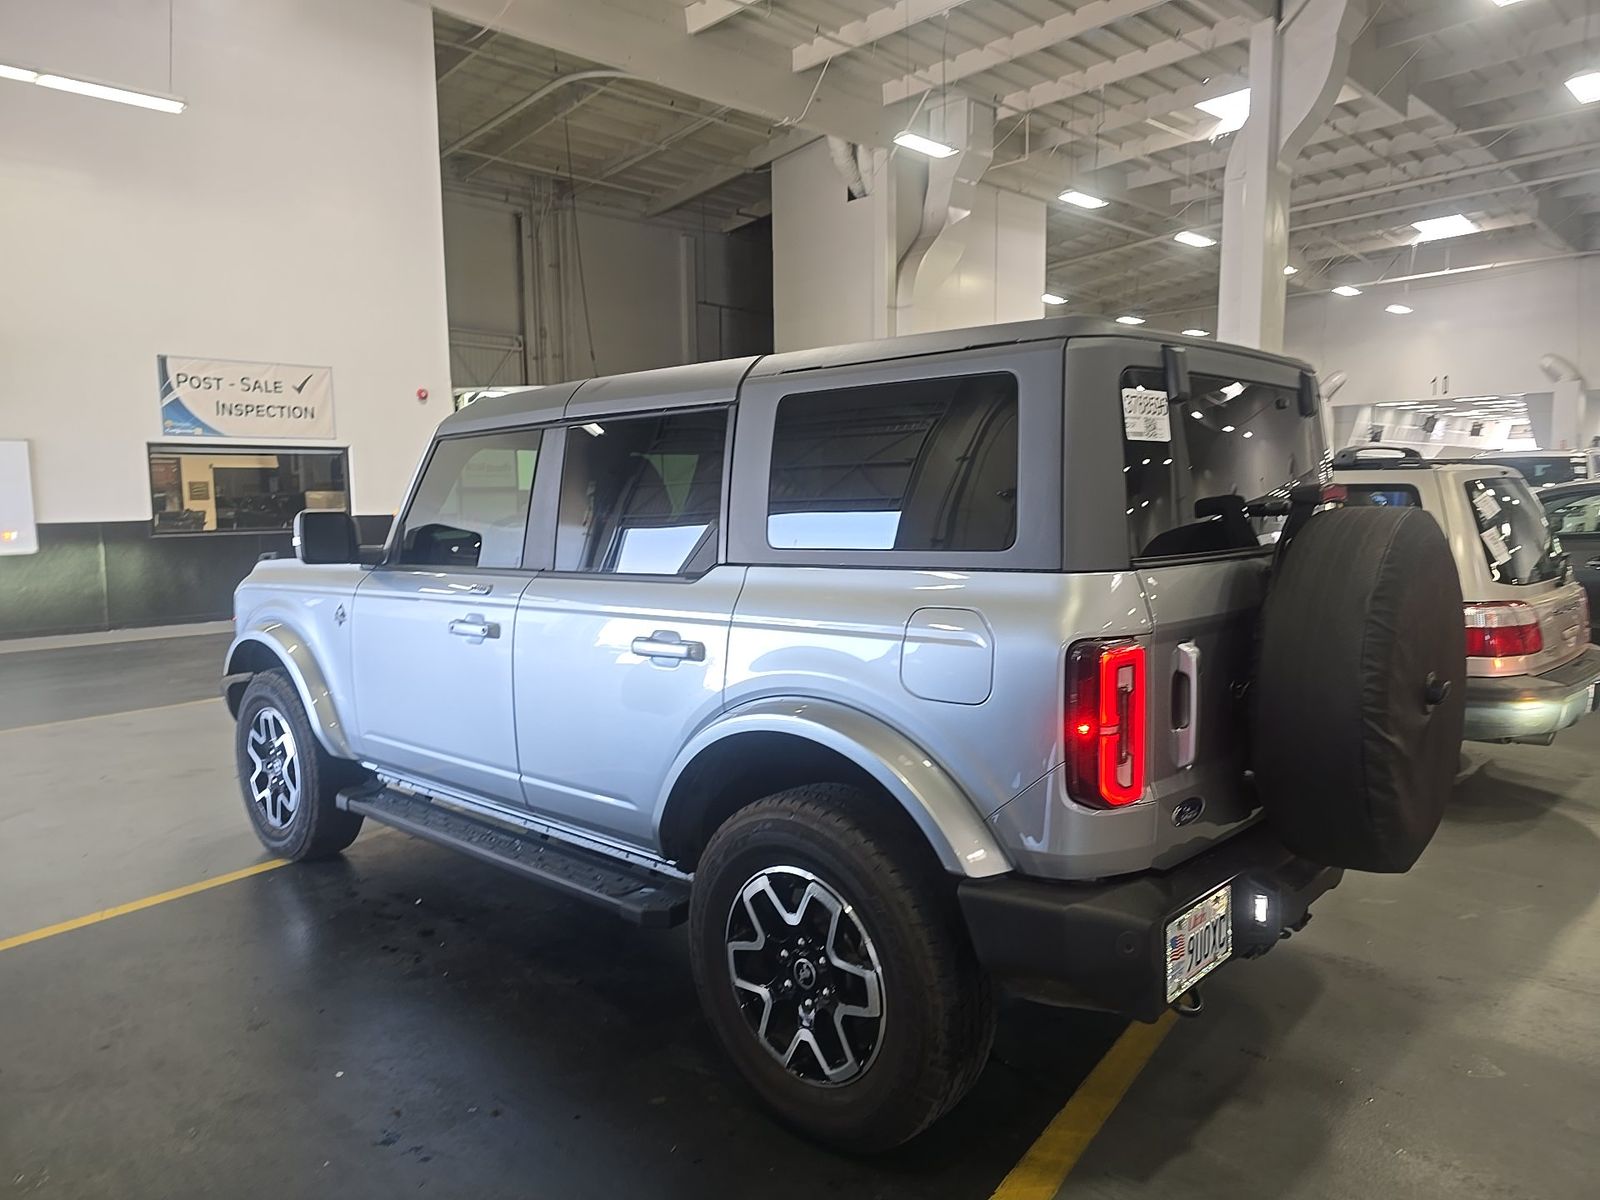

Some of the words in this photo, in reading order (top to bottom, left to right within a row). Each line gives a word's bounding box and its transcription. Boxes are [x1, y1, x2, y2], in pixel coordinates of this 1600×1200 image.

[176, 373, 224, 391] POST
[240, 376, 284, 394] SALE
[215, 400, 316, 420] INSPECTION
